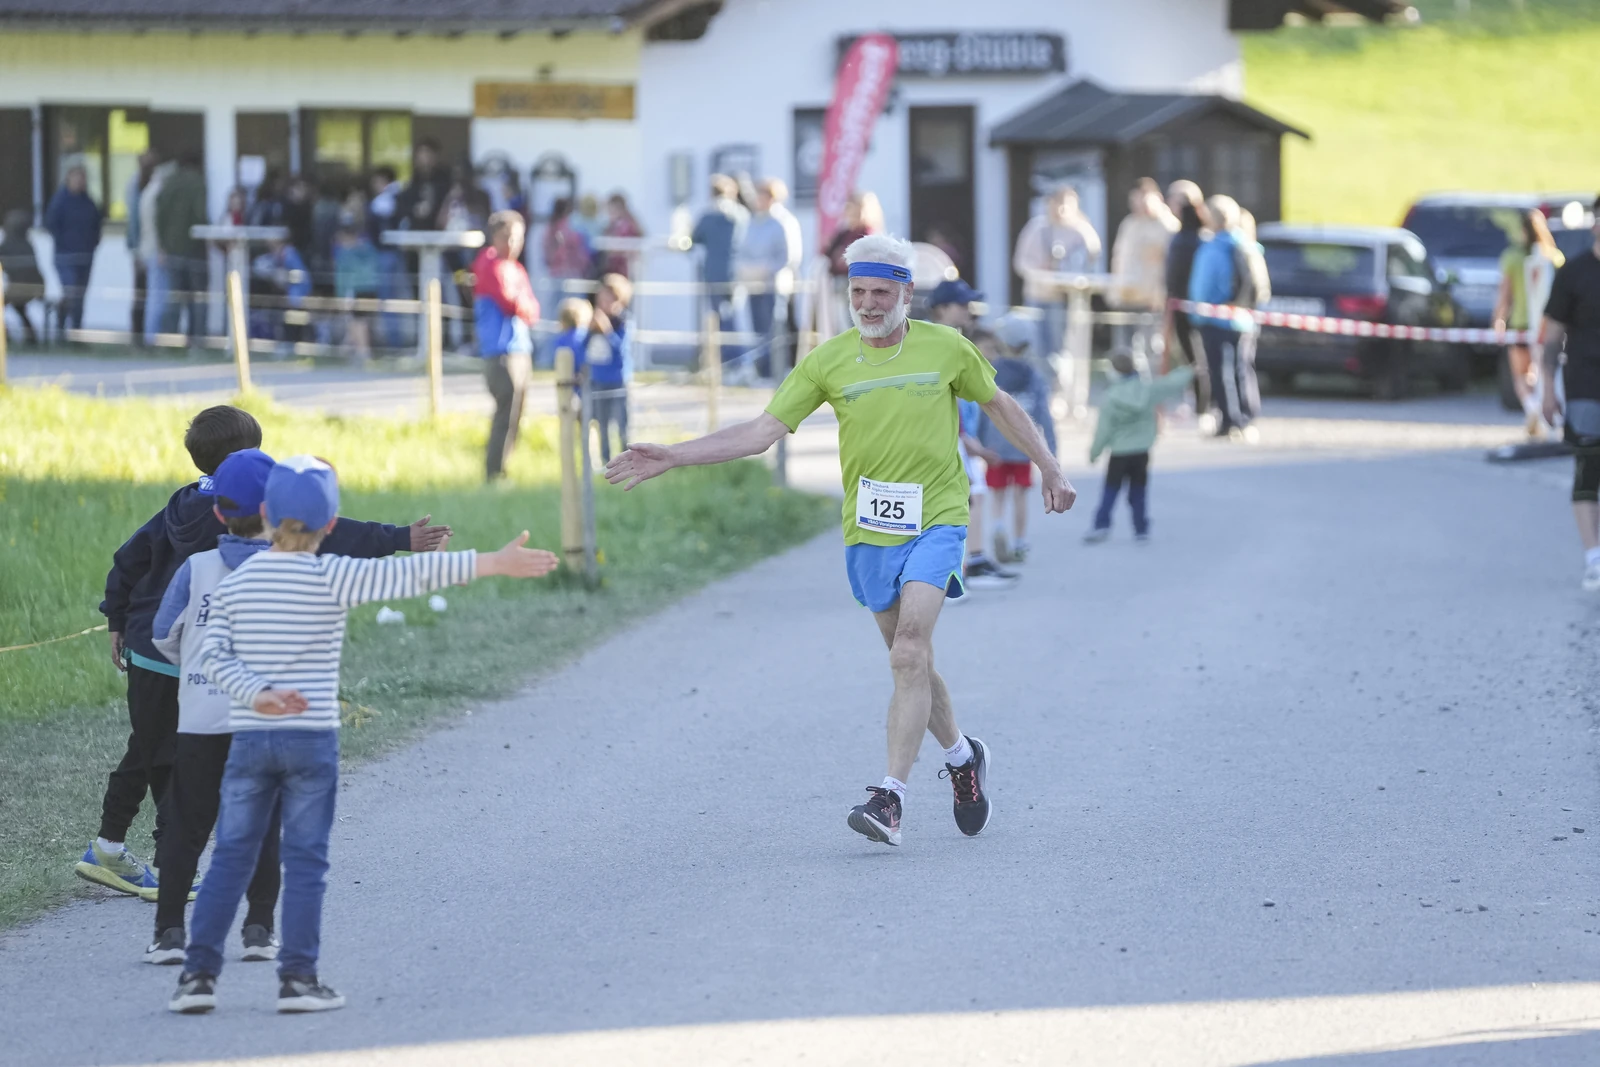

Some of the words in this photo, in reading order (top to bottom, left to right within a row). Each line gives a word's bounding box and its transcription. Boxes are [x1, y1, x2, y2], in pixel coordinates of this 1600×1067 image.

[870, 498, 905, 519] 125
[200, 593, 211, 608] S
[196, 609, 210, 623] H
[188, 673, 207, 684] POS
